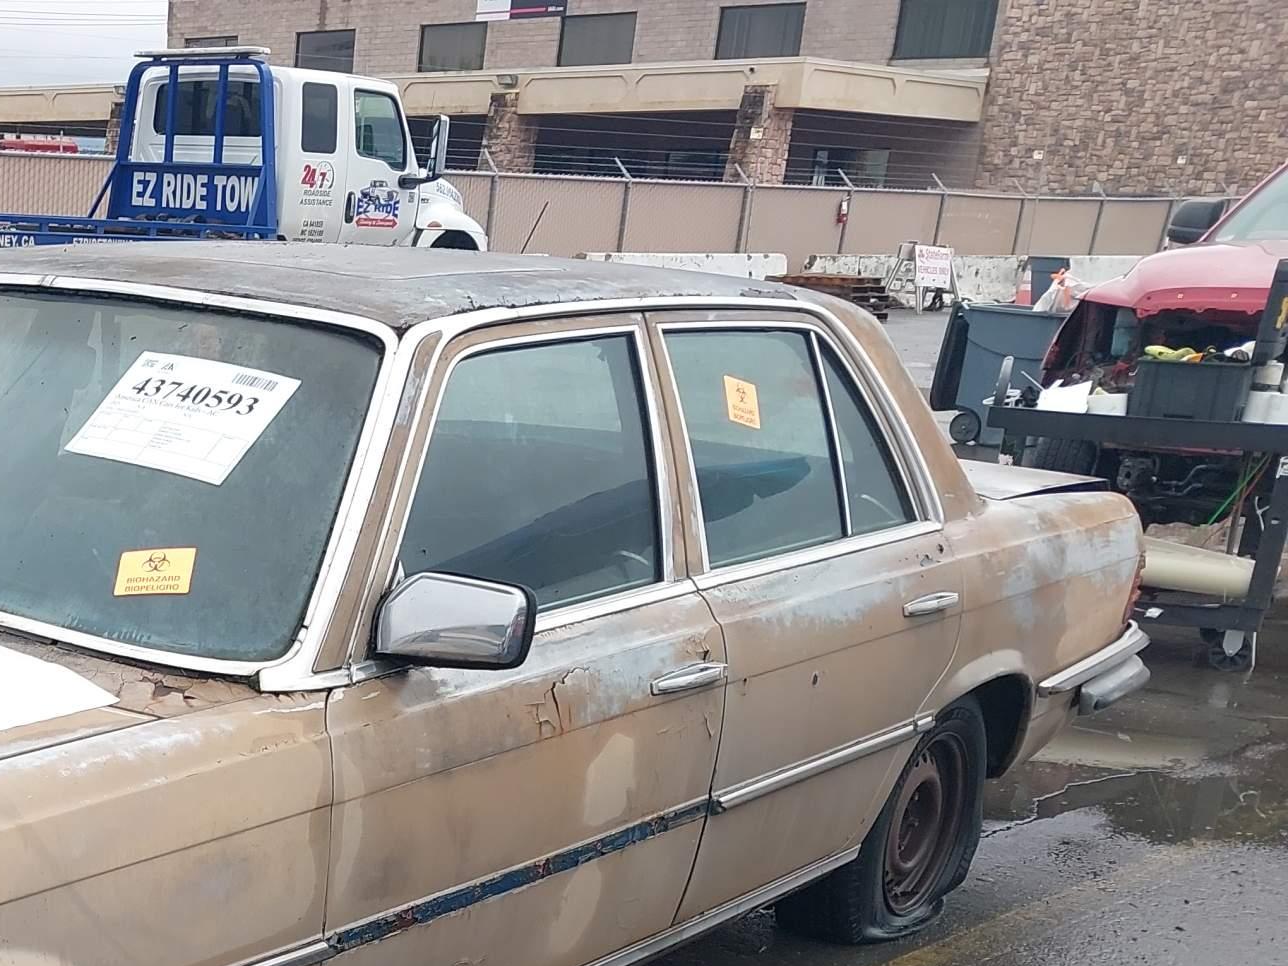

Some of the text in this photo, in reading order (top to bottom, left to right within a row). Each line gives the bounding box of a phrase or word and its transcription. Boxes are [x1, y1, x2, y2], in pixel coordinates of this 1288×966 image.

[132, 171, 259, 212] EZ RIDE TOW
[303, 189, 331, 197] ROADSIDE
[300, 198, 333, 207] ASSISTANCE
[356, 197, 371, 217] EZ
[21, 235, 36, 247] CA
[132, 377, 260, 416] 43740593
[126, 575, 181, 584] BIOHAZARD
[124, 583, 180, 593] BIOPELIGRO
